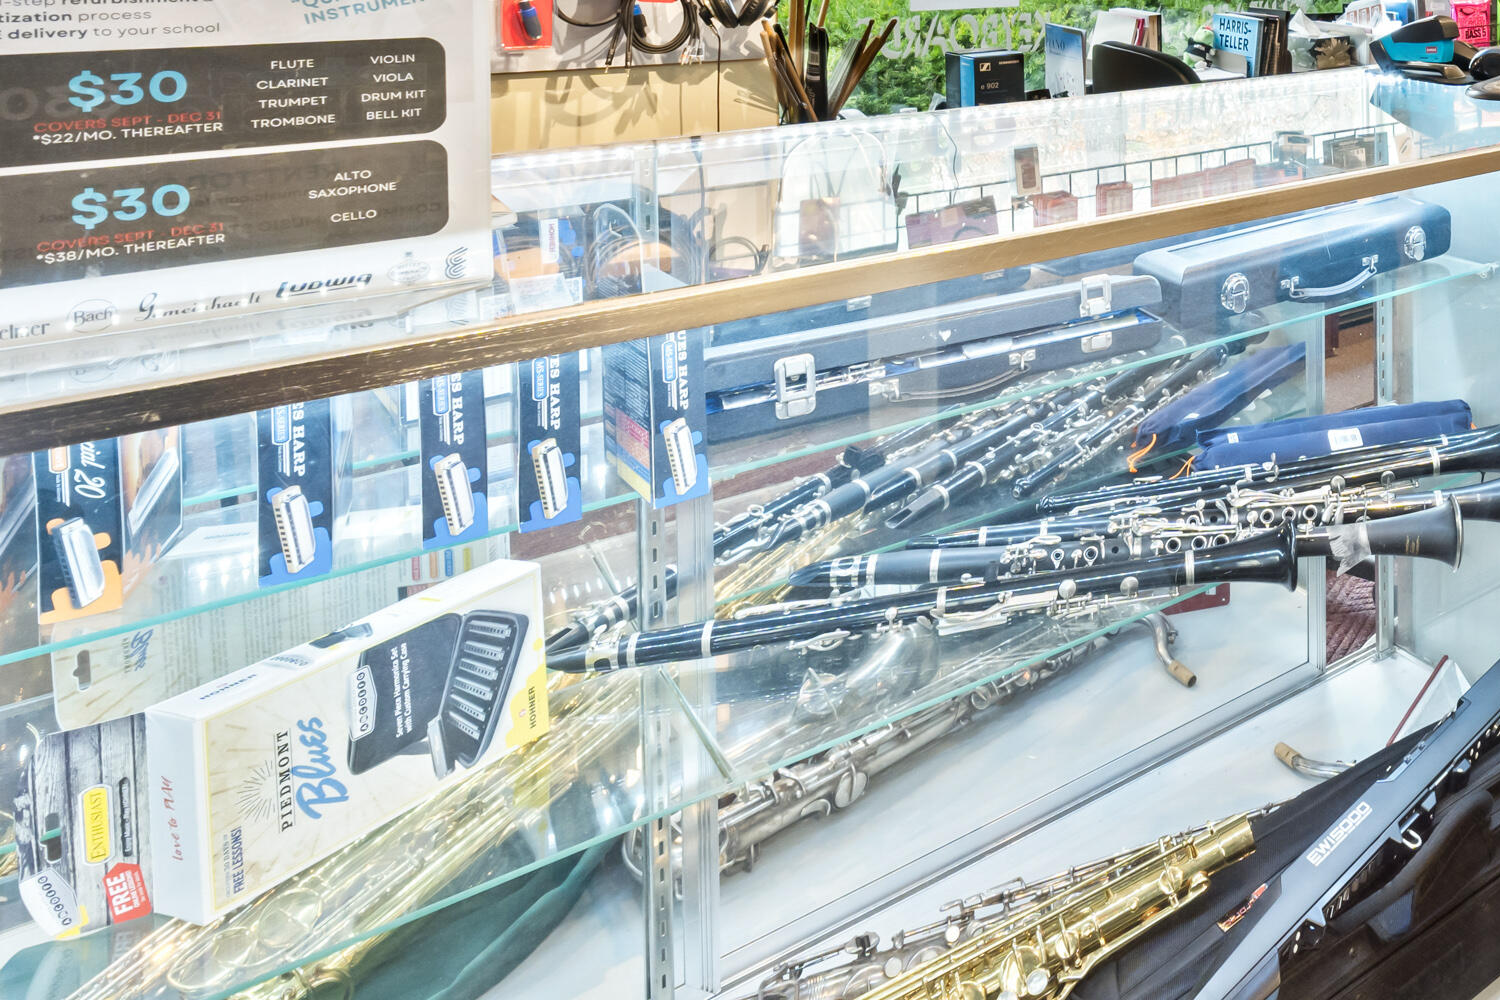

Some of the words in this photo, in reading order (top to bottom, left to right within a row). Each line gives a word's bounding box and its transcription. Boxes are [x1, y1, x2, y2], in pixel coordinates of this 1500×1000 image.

[1219, 17, 1251, 35] HARRIS-
[1465, 28, 1480, 39] BASS
[1219, 33, 1249, 52] TELLER
[270, 59, 314, 70] FLUTE
[370, 54, 415, 65] VIOLIN
[256, 77, 328, 90] CLARINET
[373, 72, 414, 83] VIOLA
[986, 81, 999, 90] 902
[68, 70, 188, 113] $30
[258, 95, 328, 109] TRUMPET
[361, 91, 402, 103] DRUM
[251, 114, 336, 129] TROMBONE
[333, 169, 372, 182] ALTO
[308, 181, 397, 199] SAXOPHONE
[71, 183, 191, 230] $30
[330, 209, 378, 223] CELLO
[678, 364, 689, 410] HARP
[549, 383, 561, 431] HARP
[391, 661, 401, 698] Harmonica
[401, 661, 411, 690] Carrying
[402, 690, 412, 717] Custom
[528, 686, 536, 729] HOHNER
[291, 717, 350, 820] Blues
[276, 730, 293, 833] PIEDMONT
[89, 791, 108, 861] ENTHUSIAST
[168, 816, 177, 828] to
[1306, 801, 1373, 866] EWI5000
[171, 833, 184, 862] love
[230, 826, 244, 868] LESSONS!
[106, 871, 134, 916] FREE
[233, 869, 245, 894] FREE
